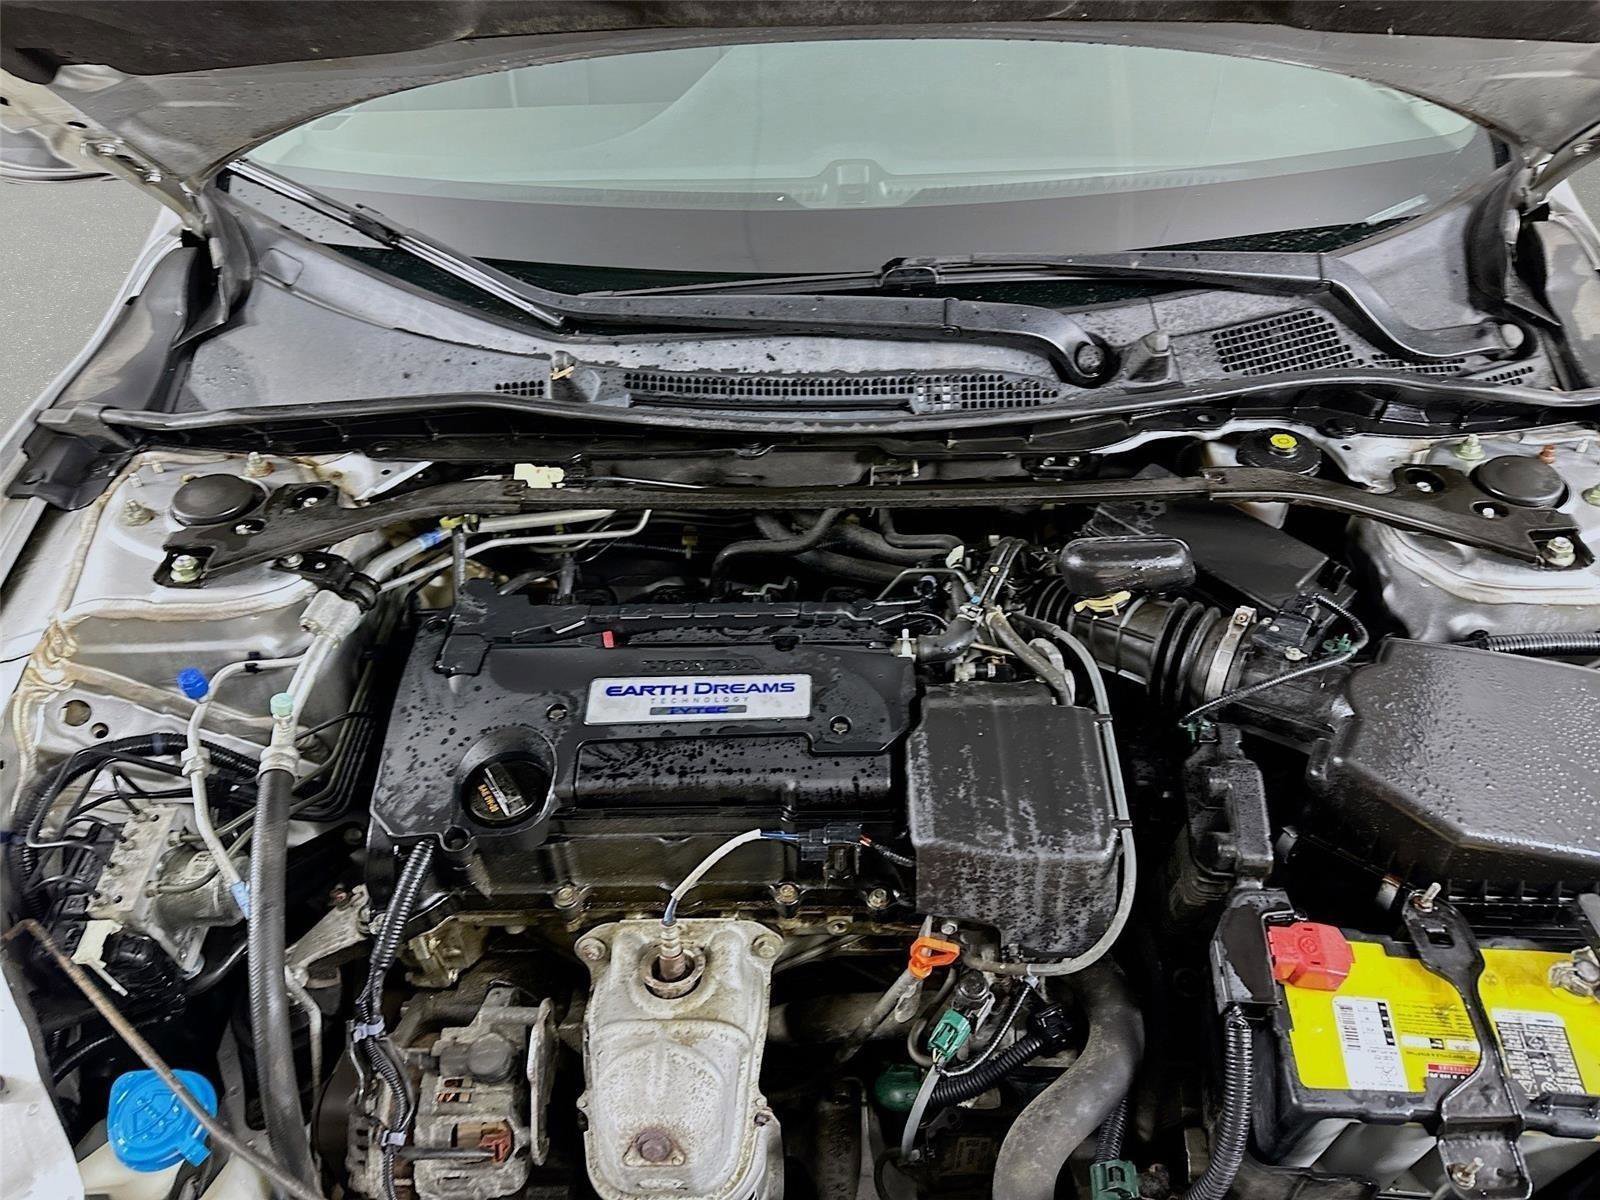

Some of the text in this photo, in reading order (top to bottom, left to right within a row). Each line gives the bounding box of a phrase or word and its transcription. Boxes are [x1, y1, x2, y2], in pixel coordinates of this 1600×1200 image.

[641, 659, 762, 672] HONDA
[606, 682, 796, 697] EARTH DREAMS
[651, 696, 749, 705] TECHNOLOGY
